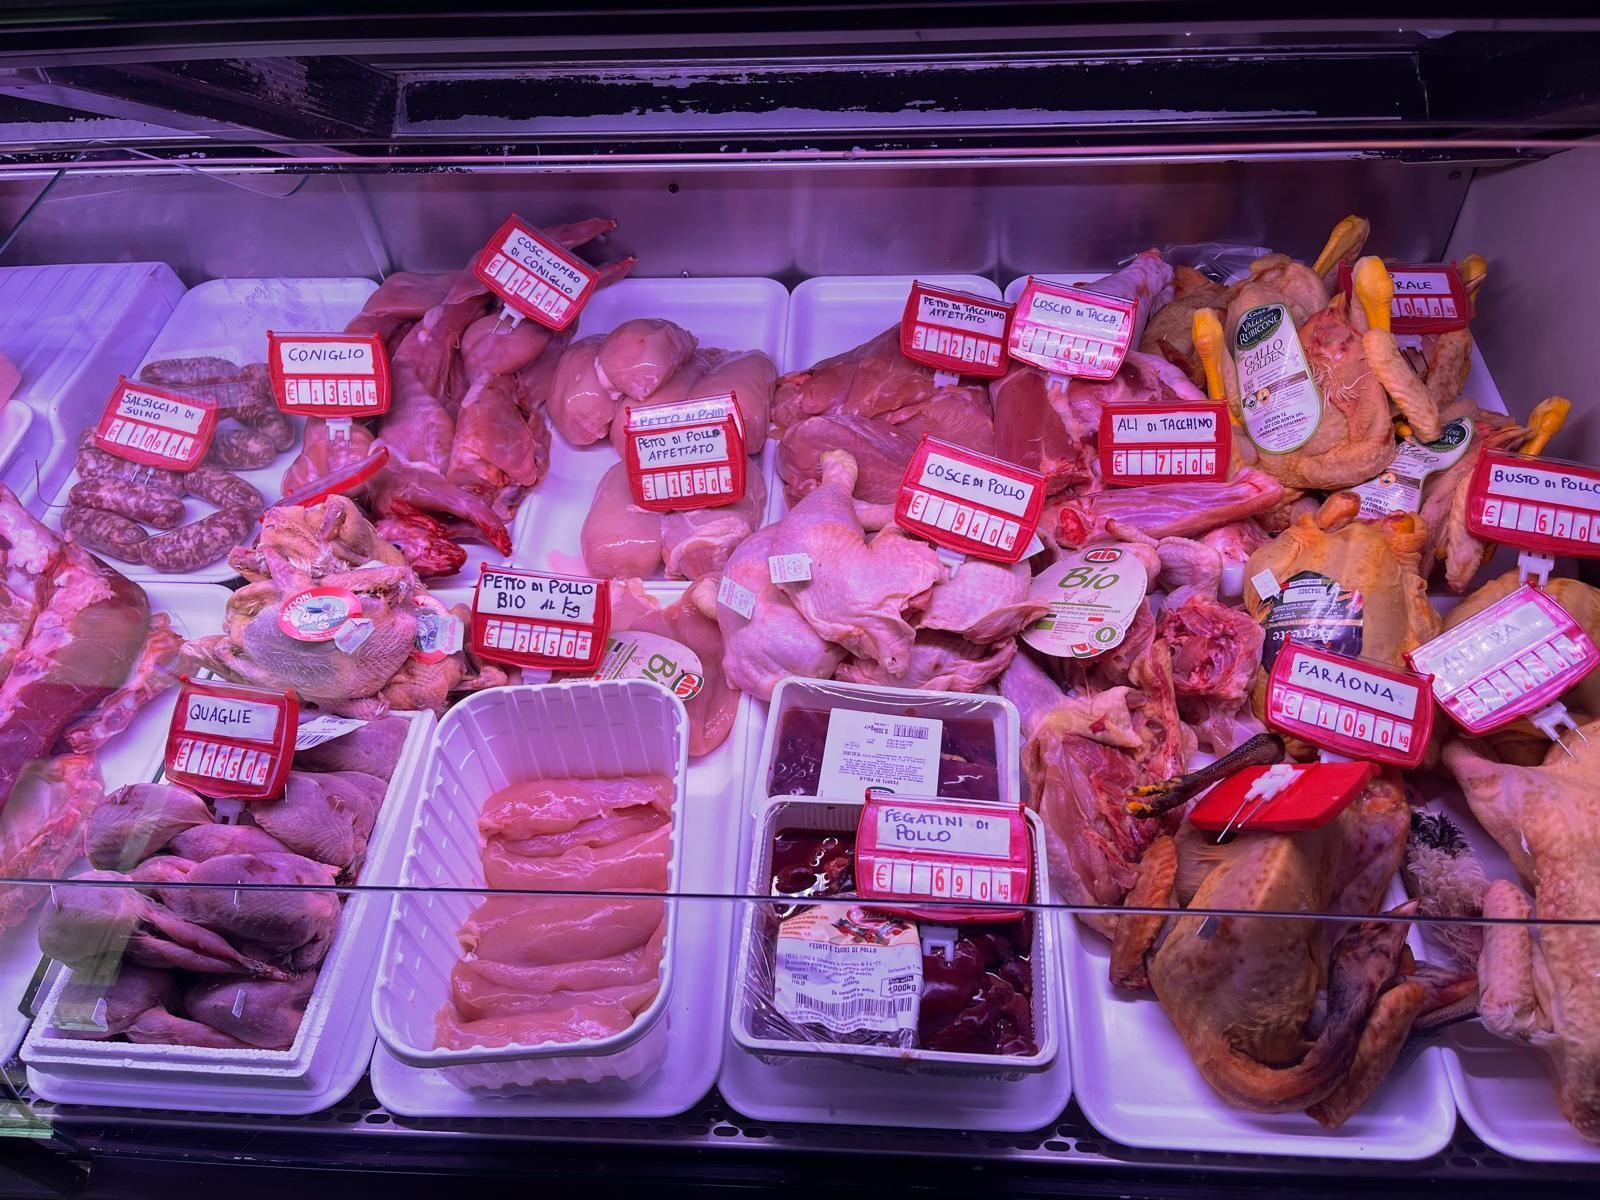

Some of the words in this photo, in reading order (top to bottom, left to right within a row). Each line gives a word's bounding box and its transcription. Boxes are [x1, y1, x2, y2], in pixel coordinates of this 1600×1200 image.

[511, 247, 520, 257] DI
[523, 255, 573, 294] CONIGLIO
[547, 258, 581, 284] LOMBO
[923, 296, 949, 308] PETTO
[963, 304, 1005, 320] TACCHINO
[929, 308, 986, 324] AFFETTATO
[1240, 314, 1278, 345] RUBICONE
[288, 348, 364, 362] CONIGLIO
[1244, 338, 1283, 368] GALLO
[1246, 351, 1285, 376] GOLDEN
[286, 382, 296, 401] €
[122, 393, 179, 415] SALSICCIA
[184, 409, 195, 420] DI
[124, 406, 160, 420] SUINO
[1117, 417, 1138, 432] ALI
[1147, 422, 1157, 433] DI
[1160, 417, 1213, 430] TACCHINO
[637, 437, 666, 451] PETTO
[686, 428, 721, 443] POLLO
[648, 443, 714, 462] AFFETTATO
[1114, 454, 1123, 473] €
[1205, 460, 1214, 474] kg
[643, 481, 652, 499] €
[927, 463, 971, 486] COSCE
[973, 477, 983, 488] DI
[988, 478, 1025, 501] POLLO
[1494, 469, 1540, 485] BUSTO
[1545, 479, 1556, 489] DI
[911, 494, 924, 515] €
[1004, 532, 1015, 549] kg
[1485, 505, 1496, 524] €
[1086, 547, 1119, 560] AIA
[483, 573, 527, 590] PETTO
[532, 582, 543, 592] DI
[549, 579, 593, 595] POLLO
[1058, 566, 1120, 590] Bio
[281, 592, 313, 622] PICCIONI
[497, 592, 525, 608] BIO
[485, 625, 496, 646] €
[1298, 661, 1394, 703] FARAONA
[189, 703, 252, 724] QUAGLIE
[1285, 697, 1296, 716] €
[1398, 731, 1409, 748] kg
[885, 808, 963, 828] FEGATINI
[976, 820, 989, 830] DI
[896, 823, 951, 843] POLLO
[875, 864, 888, 889] €
[998, 880, 1009, 899] kg
